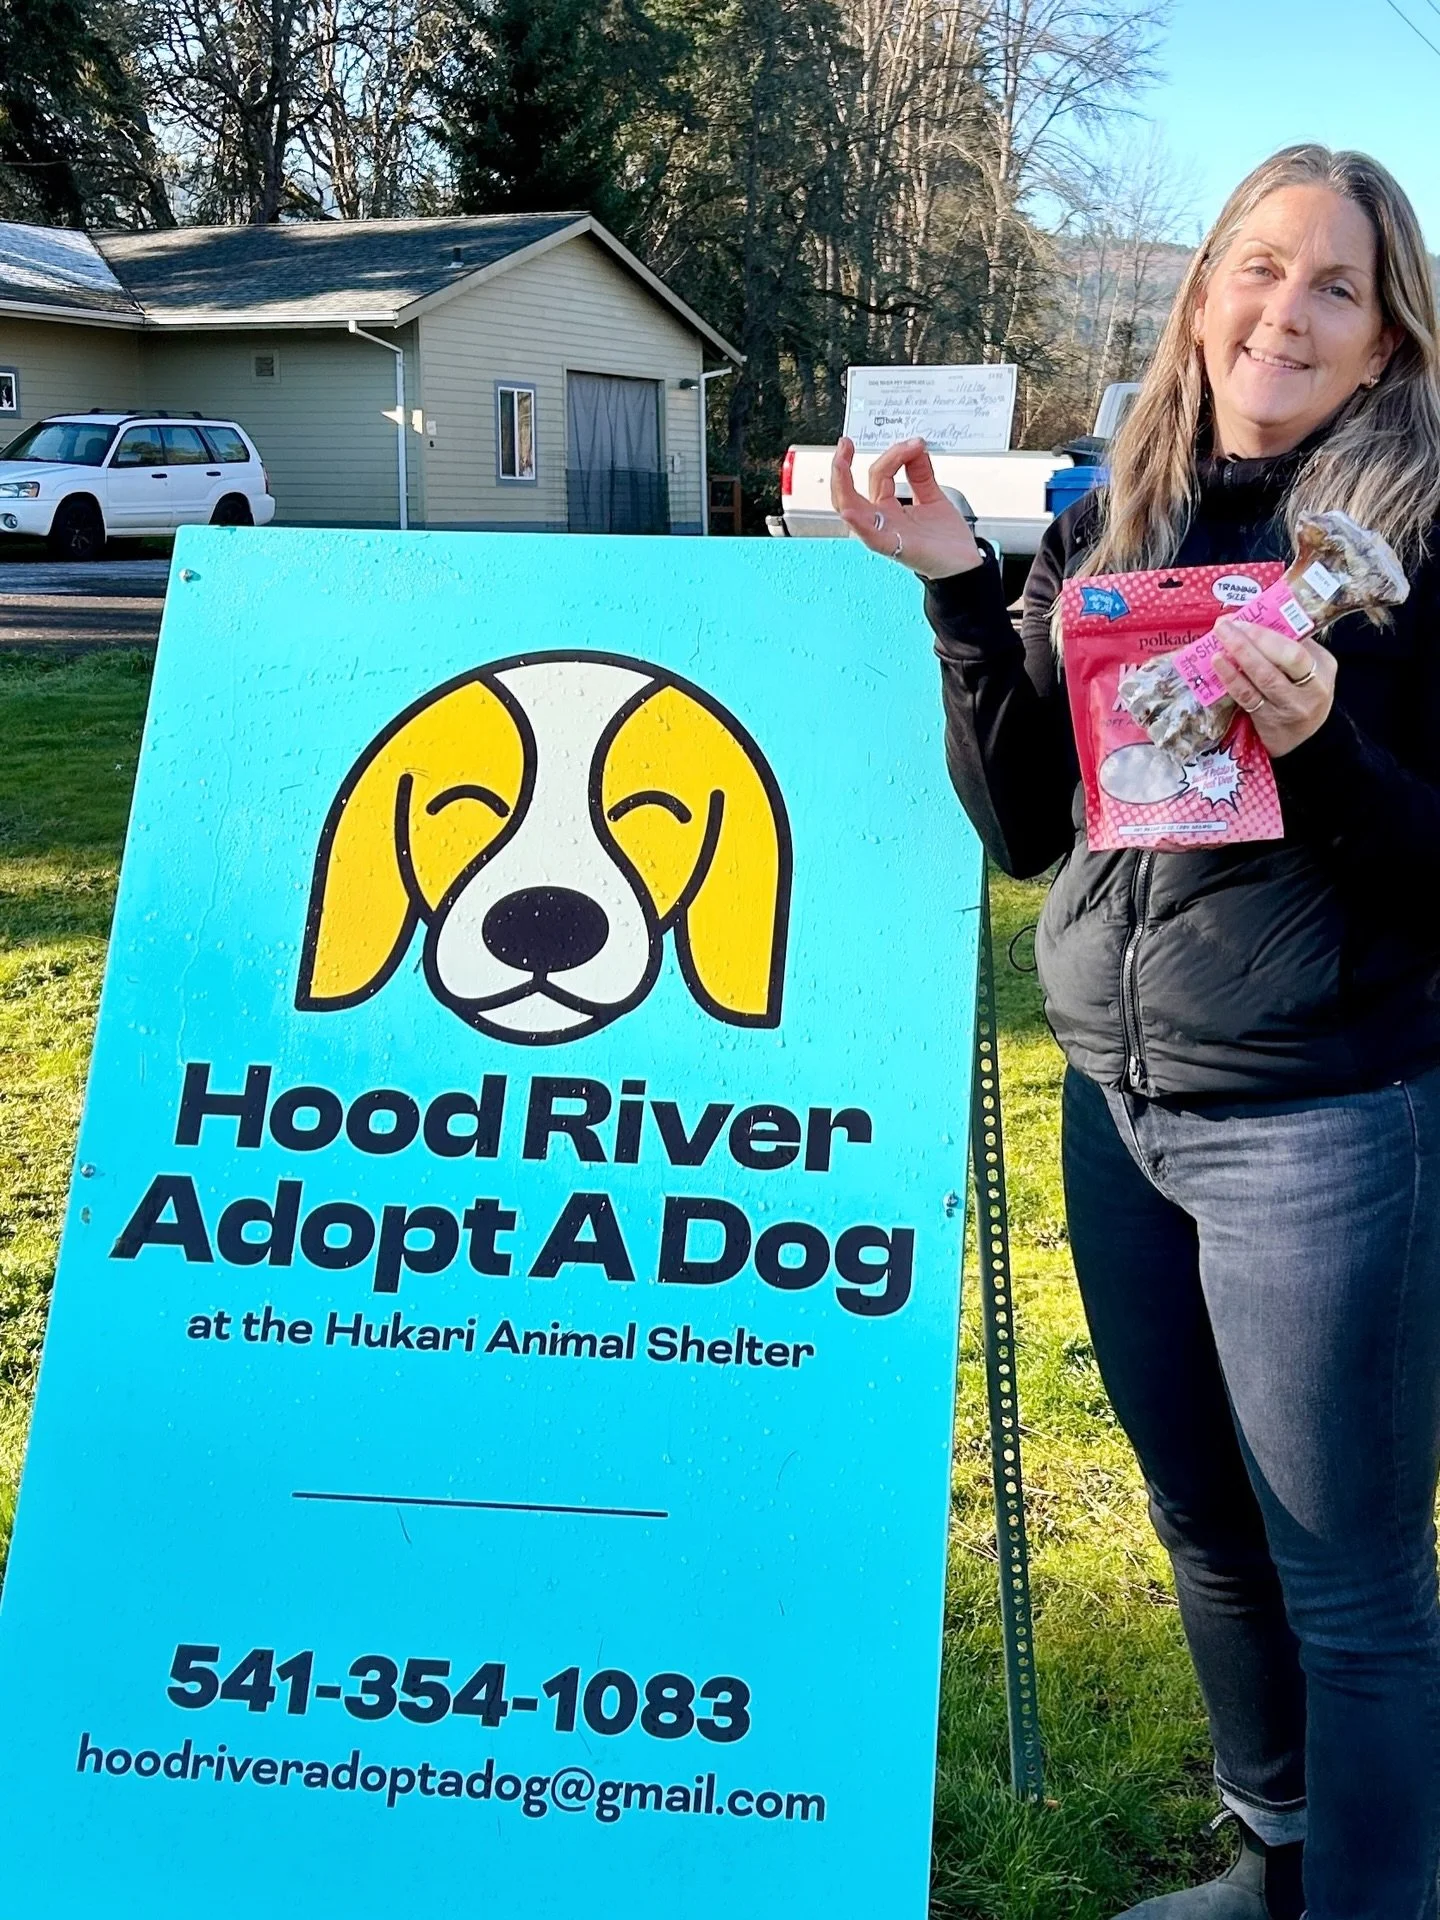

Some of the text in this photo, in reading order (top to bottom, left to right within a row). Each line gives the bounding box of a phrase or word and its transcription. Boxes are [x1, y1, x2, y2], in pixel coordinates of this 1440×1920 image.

[885, 416, 903, 424] bank
[1226, 592, 1247, 601] SIZE
[1139, 630, 1201, 650] polkado
[175, 1062, 872, 1172] Hood River
[110, 1175, 915, 1317] Adopt A Dog
[188, 1306, 814, 1367] at the Hukari Animal Shelter
[167, 1645, 750, 1743] 541-354-1083
[78, 1735, 825, 1823] hoodriveradoptadog@gmail.com
